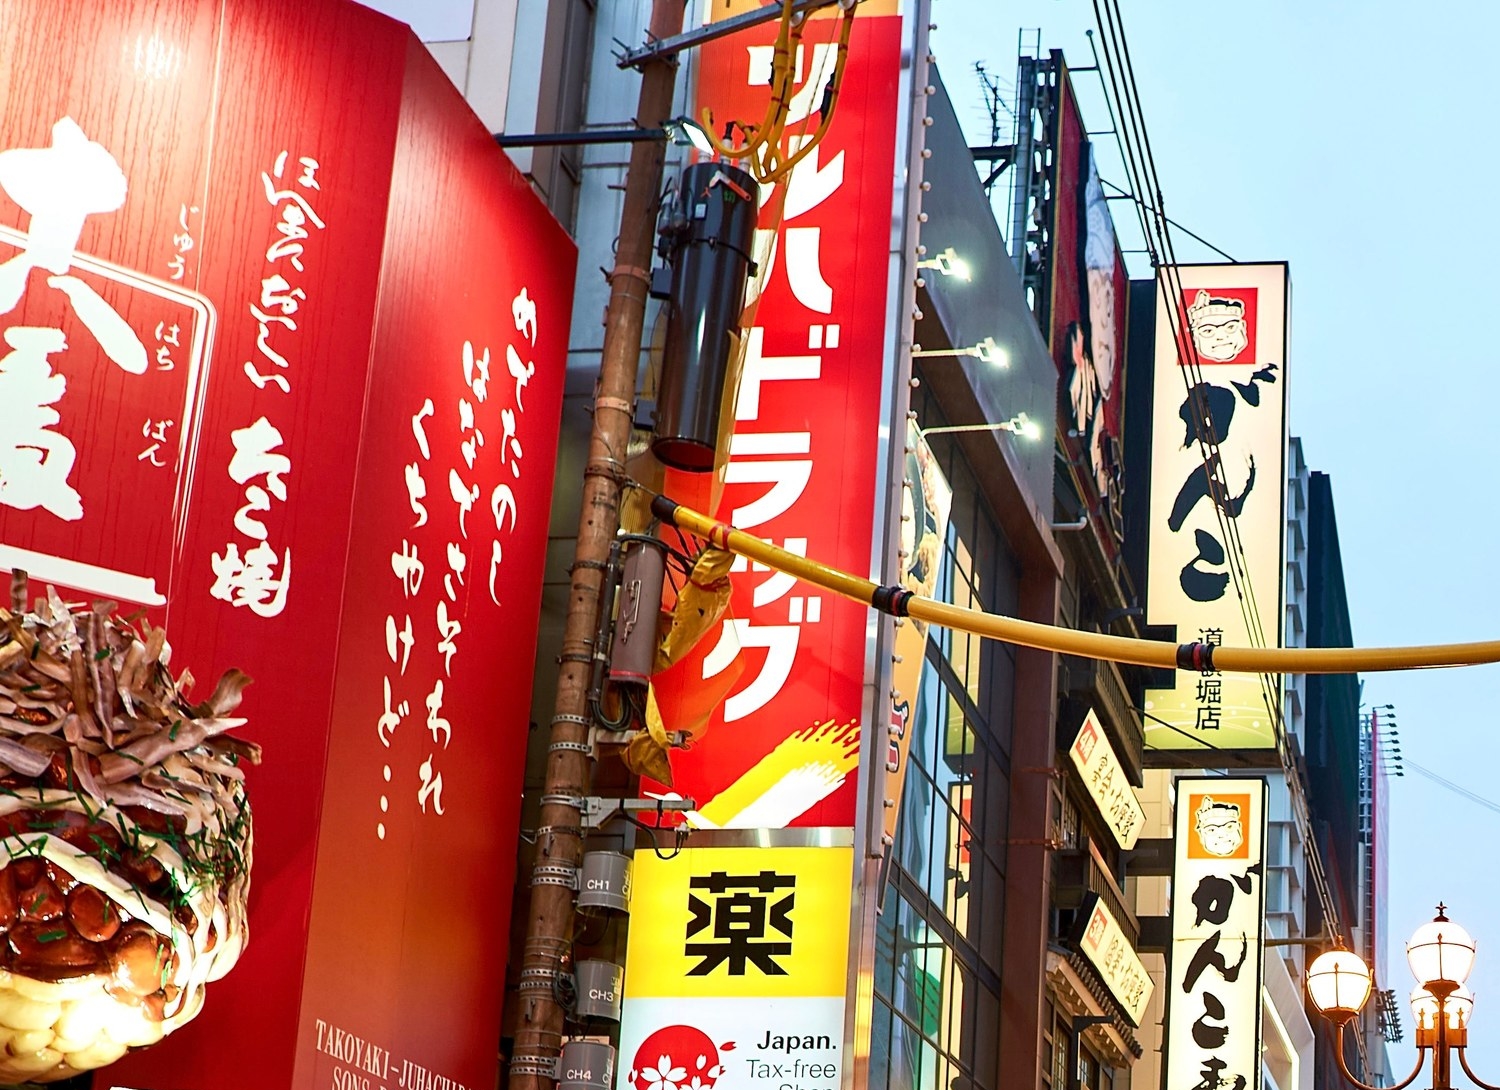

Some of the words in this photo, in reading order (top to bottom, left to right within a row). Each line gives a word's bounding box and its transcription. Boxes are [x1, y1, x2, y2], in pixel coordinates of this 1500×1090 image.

[167, 204, 200, 279] じゅう
[155, 321, 180, 371] はち
[138, 418, 174, 468] ばん
[1168, 364, 1278, 602] がんこ
[210, 417, 291, 617] たこ焼
[587, 879, 609, 890] CH1
[685, 871, 796, 976] 薬
[589, 989, 613, 1001] CH3
[757, 1031, 837, 1054] Japan.
[566, 1069, 591, 1080] CH4
[746, 1059, 836, 1079] Tax-free
